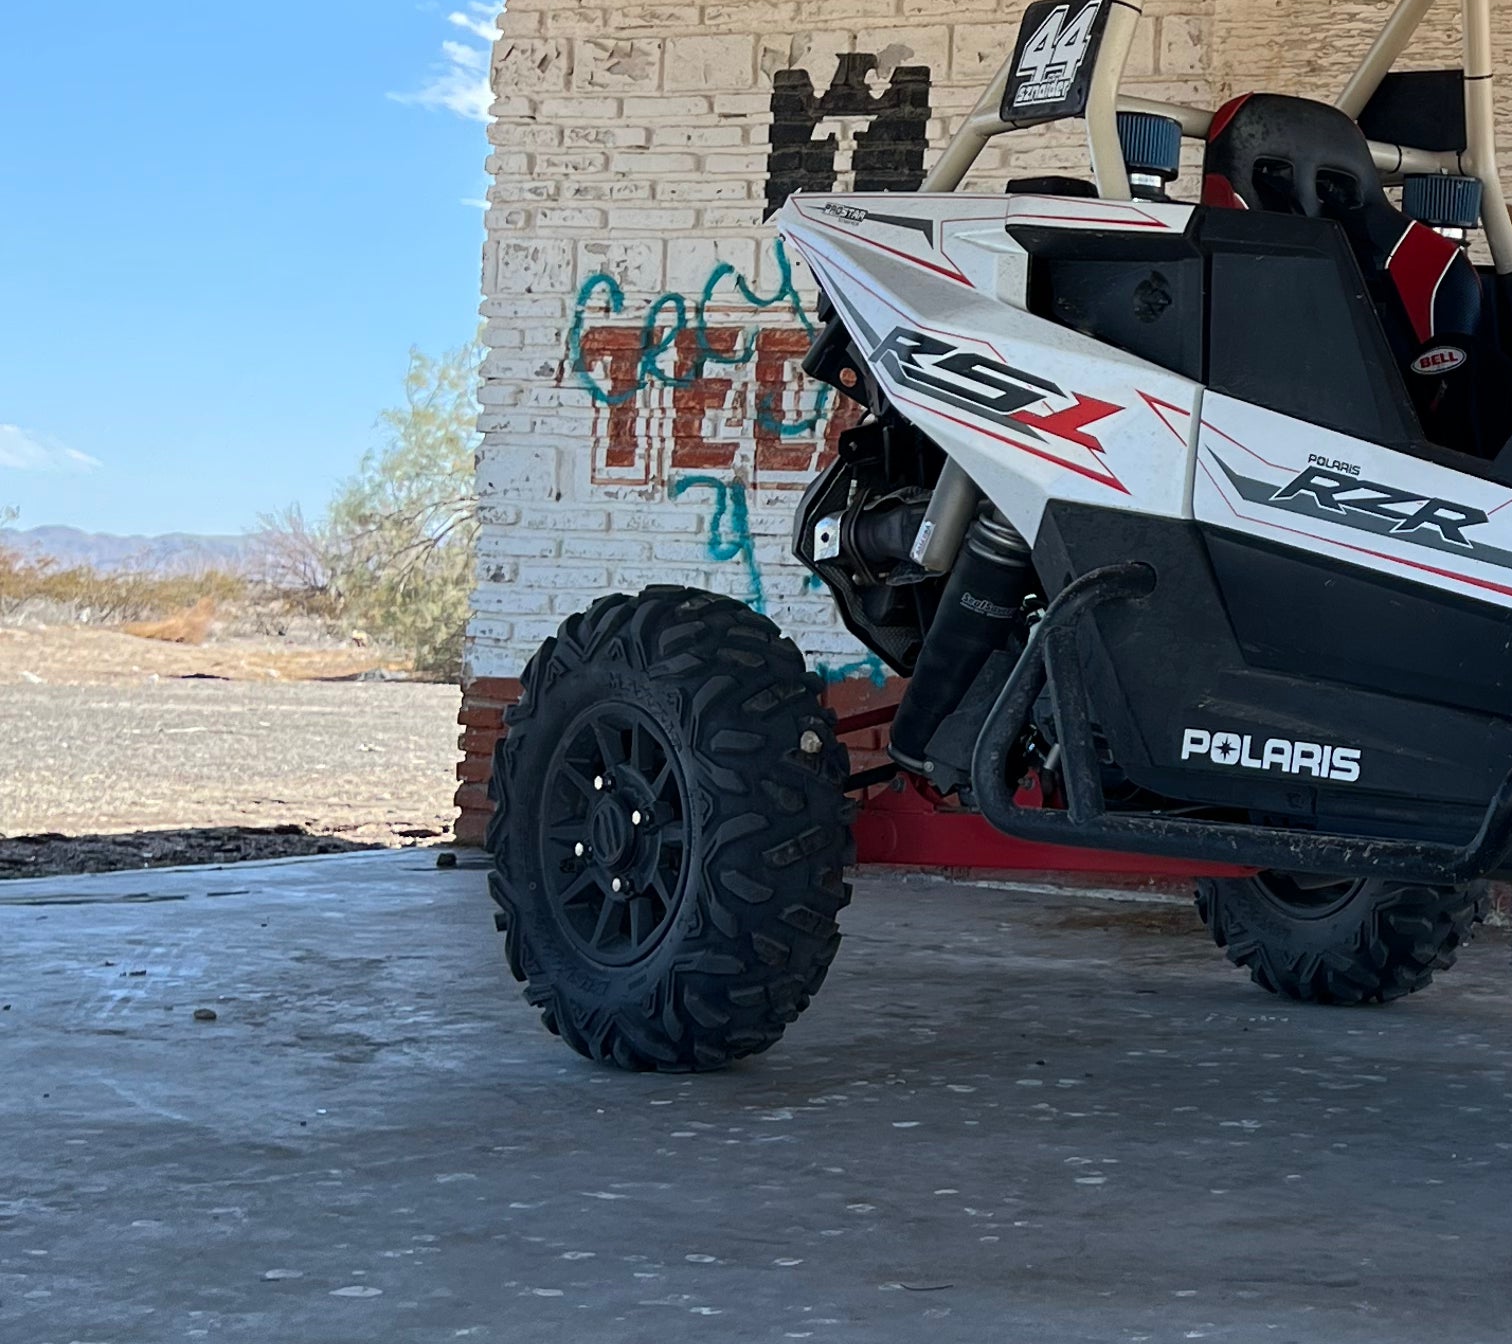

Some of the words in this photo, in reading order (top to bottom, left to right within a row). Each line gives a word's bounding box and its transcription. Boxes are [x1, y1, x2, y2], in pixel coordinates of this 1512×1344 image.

[1419, 351, 1459, 369] BELL
[1308, 453, 1361, 476] POLARIS
[1268, 465, 1489, 549] RZR
[1181, 728, 1362, 782] POLARIS
